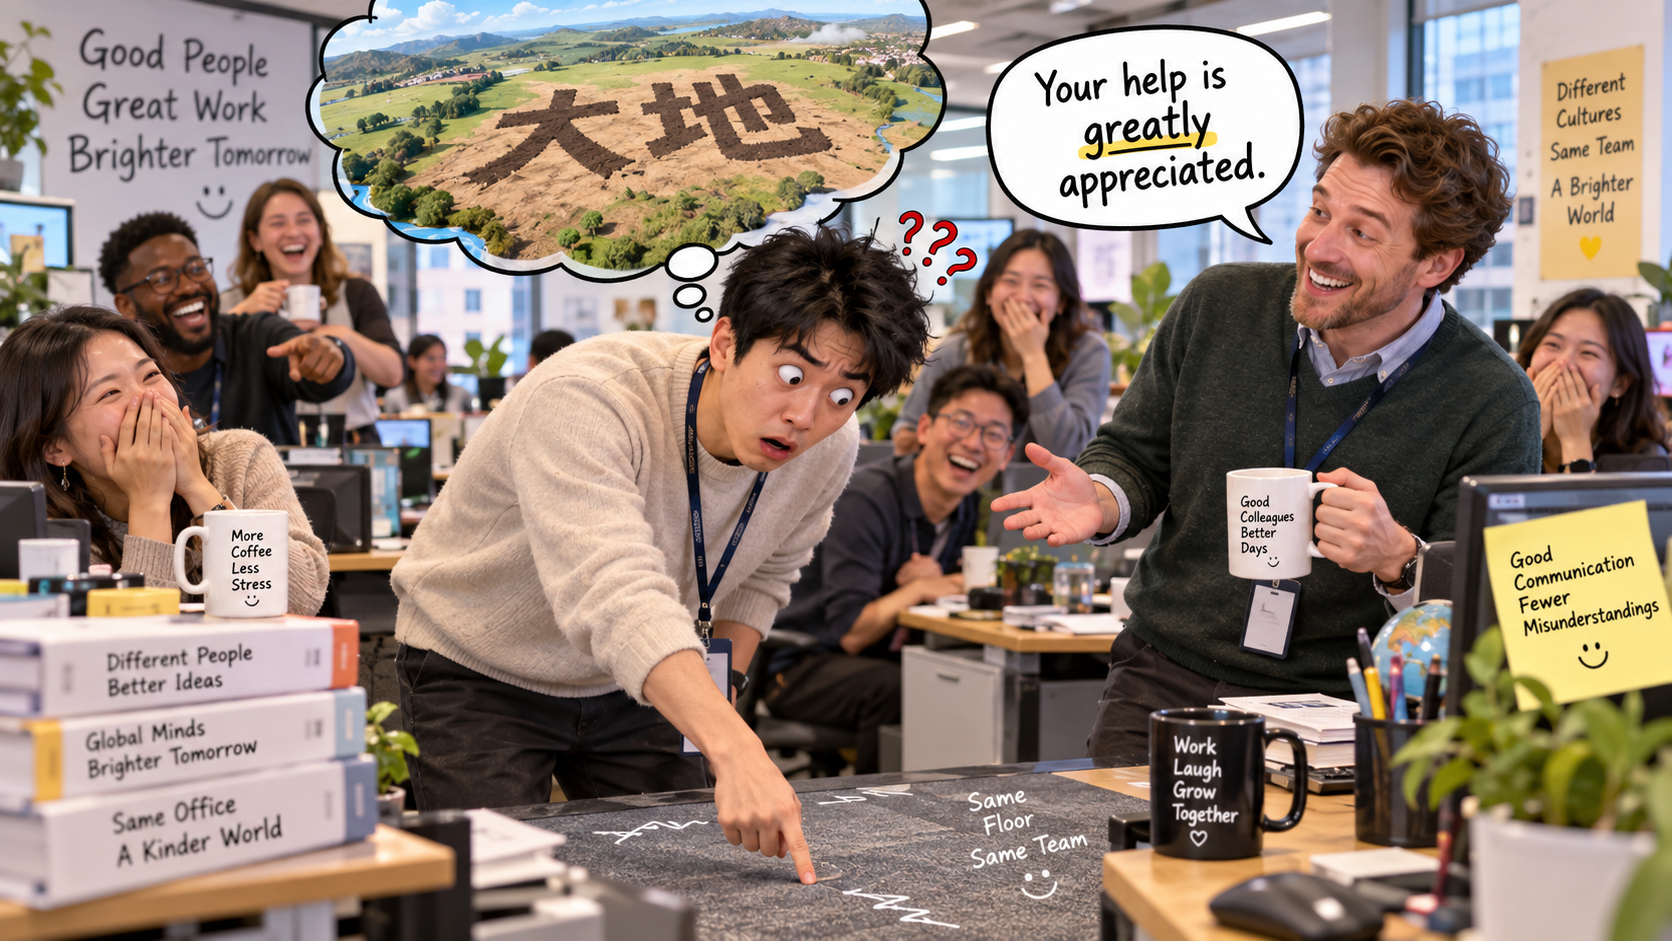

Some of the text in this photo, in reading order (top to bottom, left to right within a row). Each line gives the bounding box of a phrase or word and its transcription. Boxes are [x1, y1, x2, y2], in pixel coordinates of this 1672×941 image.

[79, 27, 268, 86] Good People
[1557, 72, 1626, 102] Different
[82, 82, 267, 124] Great Work
[1556, 106, 1622, 129] Cultures
[68, 134, 311, 183] Brighter Tomorrow
[1550, 135, 1635, 162] Same Team
[1551, 173, 1634, 201] A Brighter
[1567, 201, 1615, 226] World
[1240, 495, 1270, 508] Good
[1240, 510, 1295, 527] Colleagues
[231, 529, 264, 542] More
[1241, 525, 1277, 540] Better
[231, 544, 272, 559] Coffee
[1241, 541, 1268, 558] Days
[1510, 544, 1554, 569] Good
[231, 562, 260, 575] Less
[1513, 554, 1635, 592] Communication
[231, 578, 272, 592] Stress
[1517, 592, 1571, 615] Fewer
[1523, 599, 1660, 637] Misunderstandings
[107, 643, 253, 673] Different People
[108, 671, 223, 698] Better Ideas
[85, 718, 206, 752] Global Minds
[1174, 735, 1217, 755] Work
[87, 738, 258, 781] Brighter Tomorrow
[1173, 758, 1222, 782] Laugh
[967, 790, 1027, 813] Same
[1173, 779, 1217, 800] Grow
[112, 796, 237, 835] Same Office
[982, 813, 1034, 836] Floor
[1172, 803, 1239, 827] Together
[116, 814, 283, 867] A Kinder World
[970, 833, 1088, 869] Same Team
